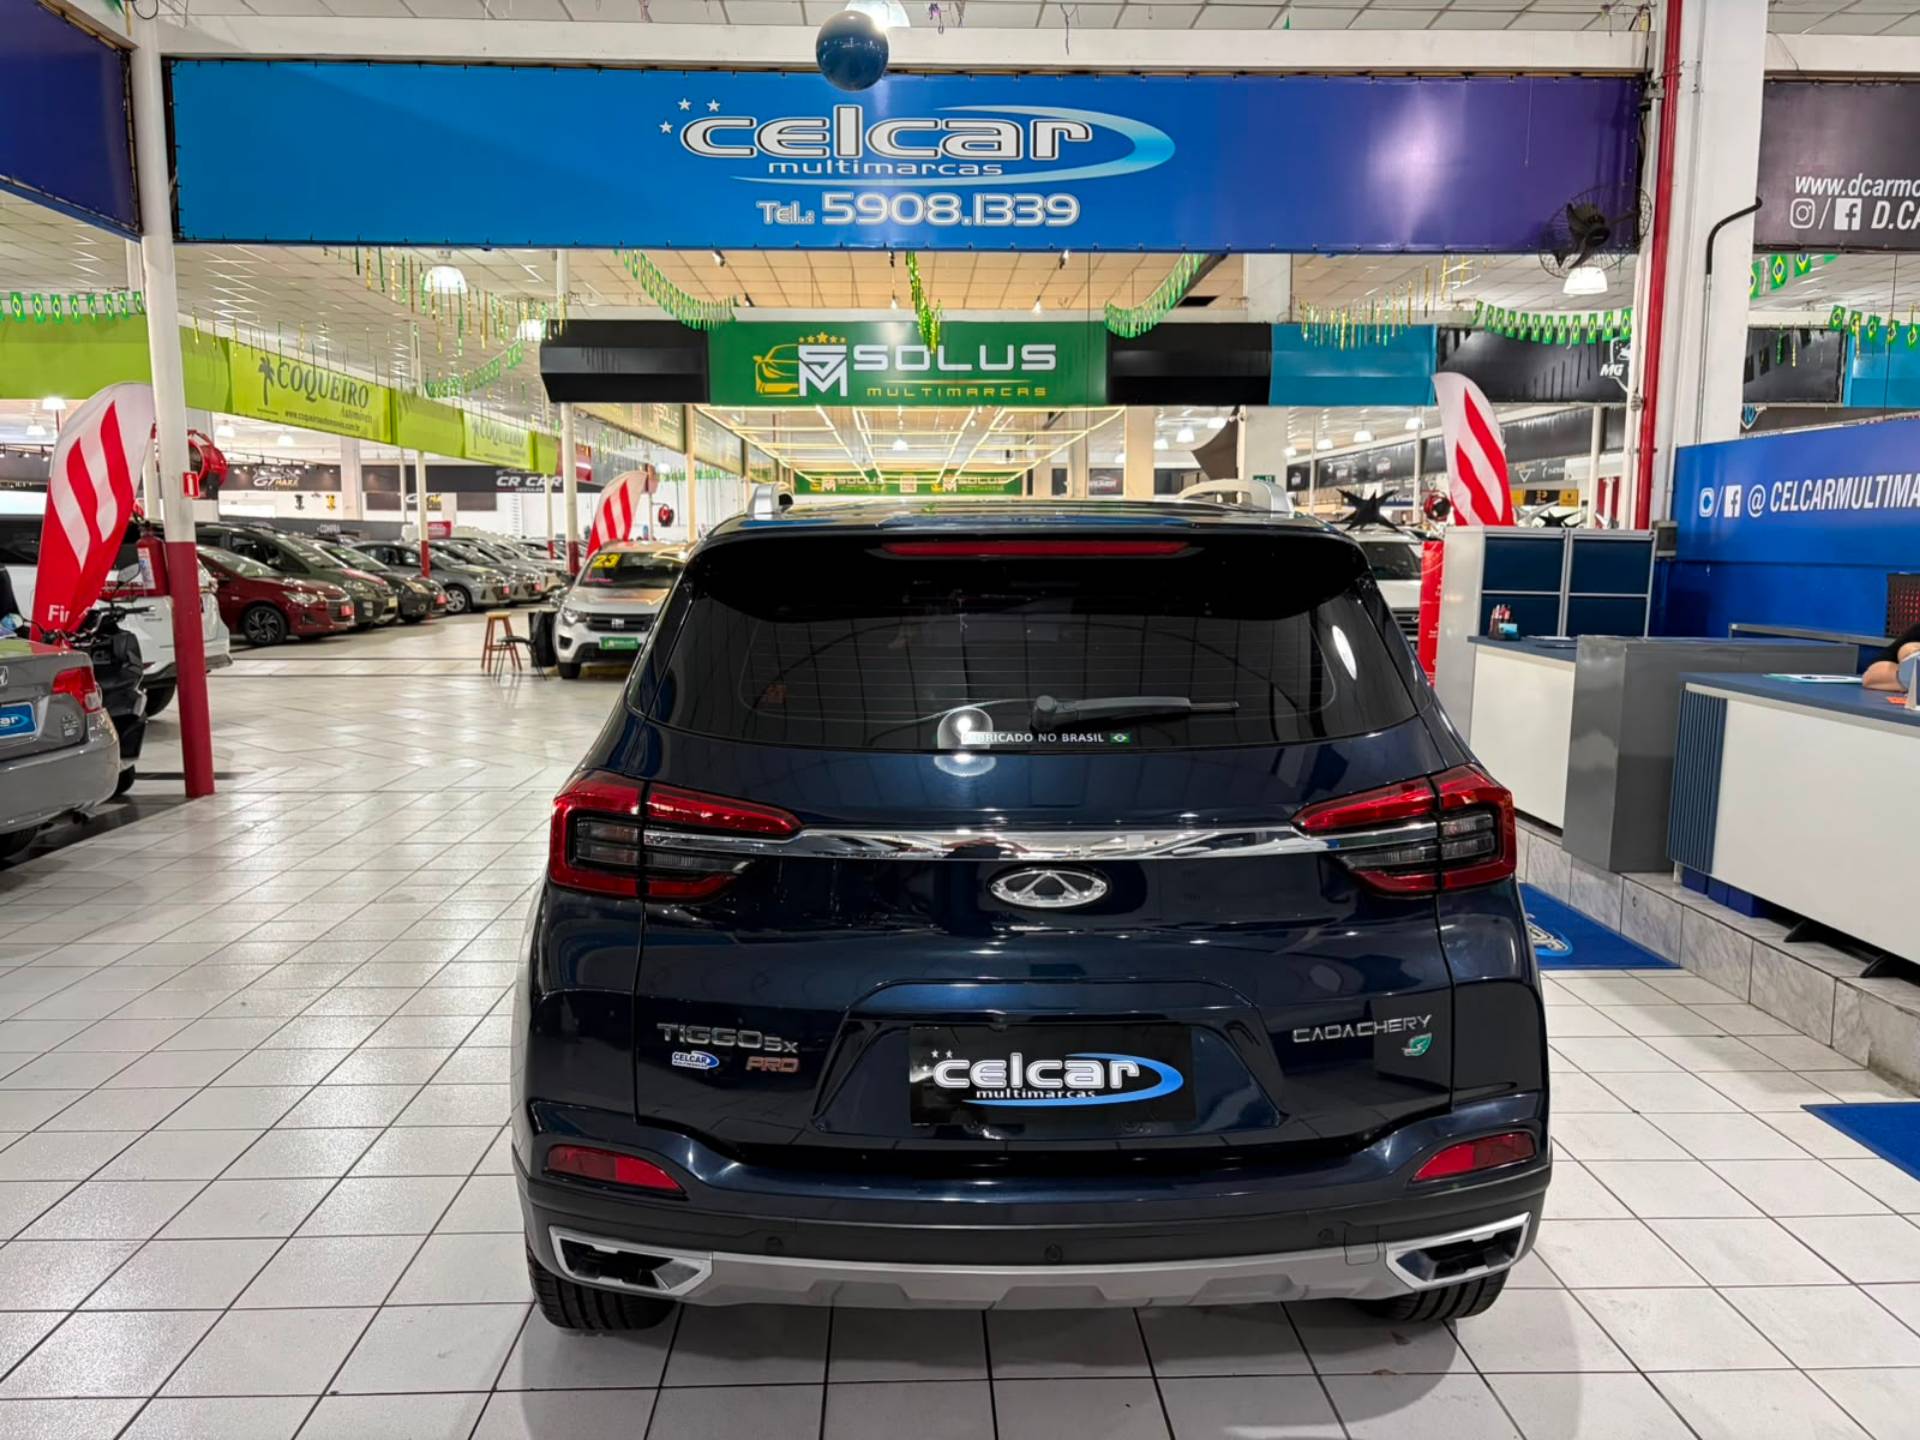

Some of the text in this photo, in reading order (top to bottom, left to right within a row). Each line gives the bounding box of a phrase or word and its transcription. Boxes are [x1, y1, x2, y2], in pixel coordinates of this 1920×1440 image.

[680, 105, 1093, 160] celcar
[768, 159, 1003, 175] multimarcas
[821, 191, 1081, 226] 5908.1339
[853, 344, 1056, 371] SOLUS
[277, 361, 369, 408] COQUEIRO
[866, 387, 1048, 397] MULTIMARCAS
[496, 476, 521, 487] CR
[593, 553, 621, 568] 23
[1038, 733, 1056, 743] NO
[1061, 733, 1104, 743] BRASIL
[673, 1053, 708, 1064] CELCAR
[745, 1056, 800, 1073] PRO
[933, 1052, 1140, 1089] celcar
[976, 1088, 1096, 1099] multimarcas
